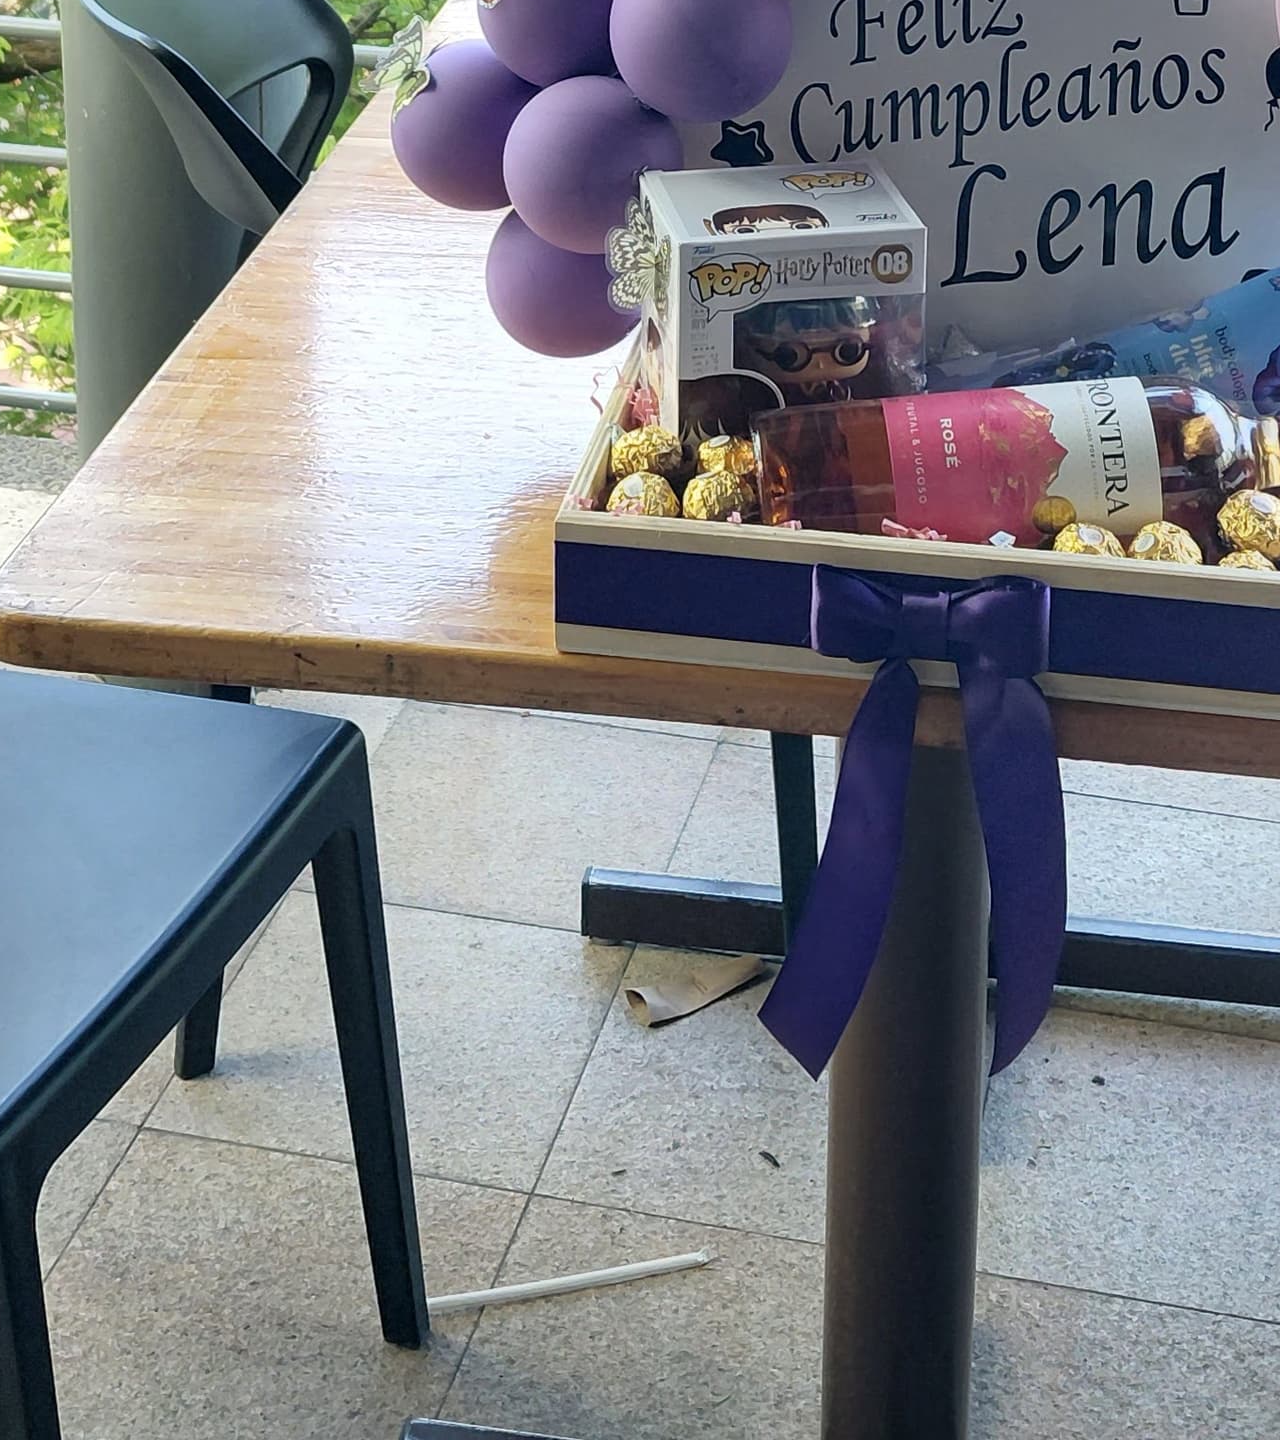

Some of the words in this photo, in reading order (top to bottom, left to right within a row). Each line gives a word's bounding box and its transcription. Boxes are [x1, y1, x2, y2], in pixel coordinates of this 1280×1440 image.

[790, 38, 1227, 168] Cumpleaños
[780, 171, 869, 192] POP!
[940, 163, 1240, 288] Lena
[688, 262, 771, 302] POP!
[773, 254, 821, 285] Harry
[823, 251, 871, 284] Potter
[876, 250, 910, 277] 08
[940, 418, 961, 468] ROSÉ
[1086, 379, 1130, 517] RONTERA
[914, 451, 927, 504] JUGOSO
